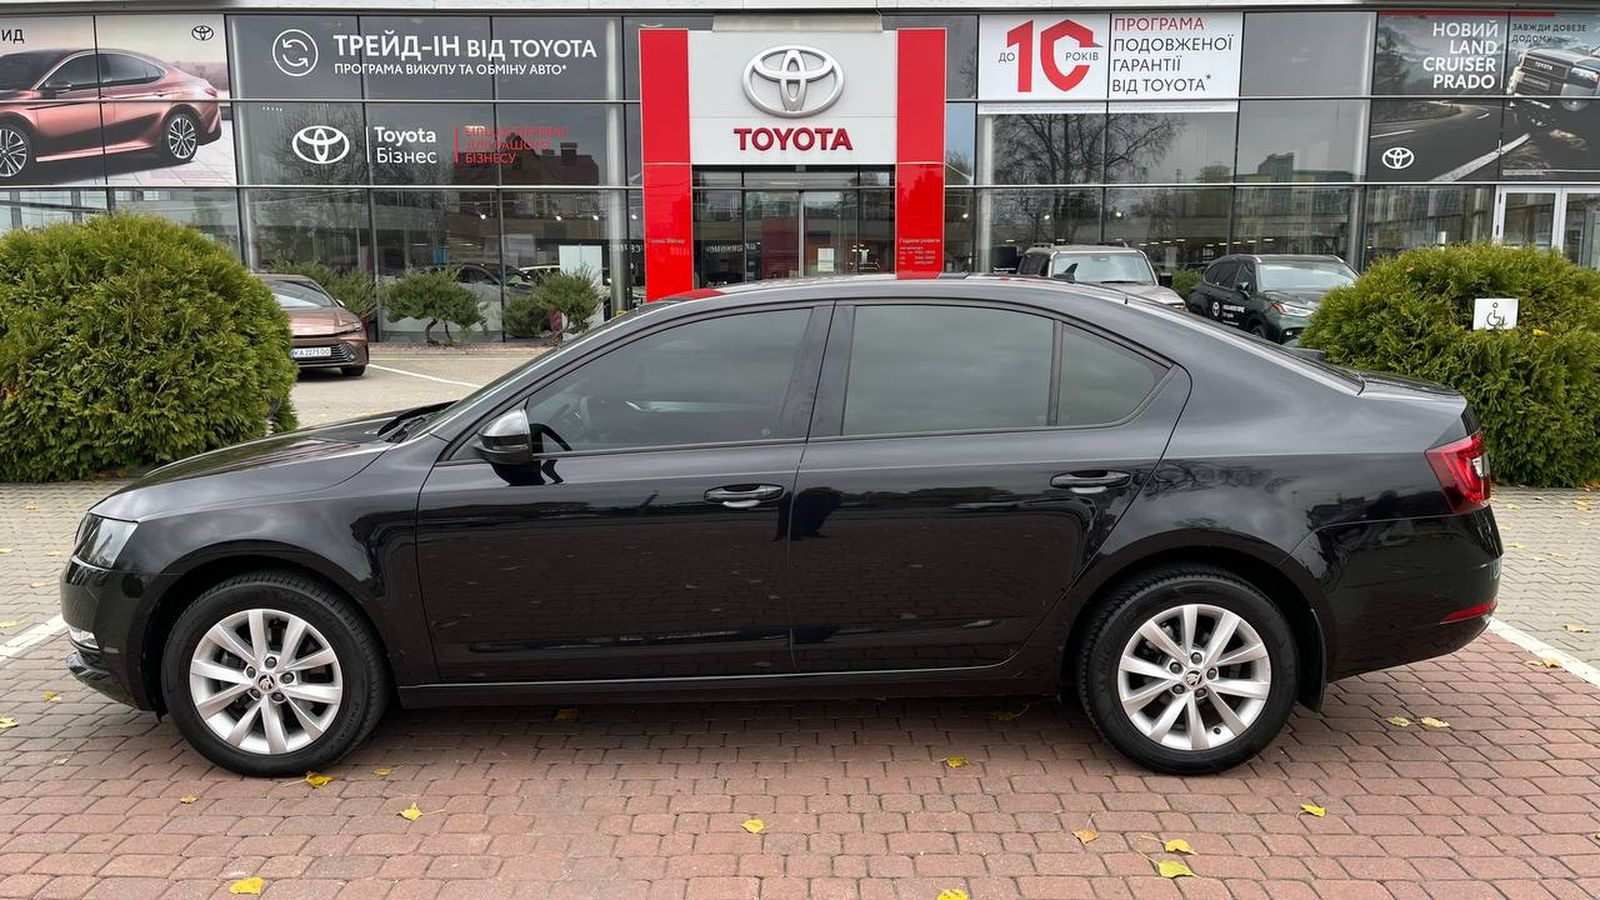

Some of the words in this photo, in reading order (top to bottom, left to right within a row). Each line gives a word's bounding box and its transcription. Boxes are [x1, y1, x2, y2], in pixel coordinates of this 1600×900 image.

[1114, 17, 1205, 31] ПРОГРАМА
[1433, 20, 1499, 38] НОВИЙ
[1512, 23, 1551, 32] ЗАВЖДИ
[1552, 24, 1587, 32] ДОВЕЗЕ
[333, 30, 460, 61] ТРЕЙД-ІН
[467, 40, 505, 61] ВІД
[510, 39, 597, 58] TOYOTA
[1114, 34, 1233, 53] ПОДОВЖЕНОЇ
[1511, 34, 1552, 44] ДОДОМУ
[1450, 40, 1497, 55] LAND
[998, 53, 1015, 63] ДО
[1065, 52, 1099, 61] РОКІВ
[1112, 55, 1183, 72] ГАРАНТІЇ
[1423, 57, 1496, 72] CRUISER
[334, 64, 403, 75] ПРОГРАМА
[406, 64, 456, 75] ВИКУПУ
[458, 65, 473, 75] ТА
[476, 64, 527, 75] ОБМІНУ
[1112, 79, 1139, 95] ВІД
[1433, 74, 1496, 90] PRADO
[374, 126, 437, 147] Toyota
[733, 127, 853, 151] TOYOTA
[377, 146, 437, 164] Бізнес
[465, 153, 517, 164] БІЗНЕСУ
